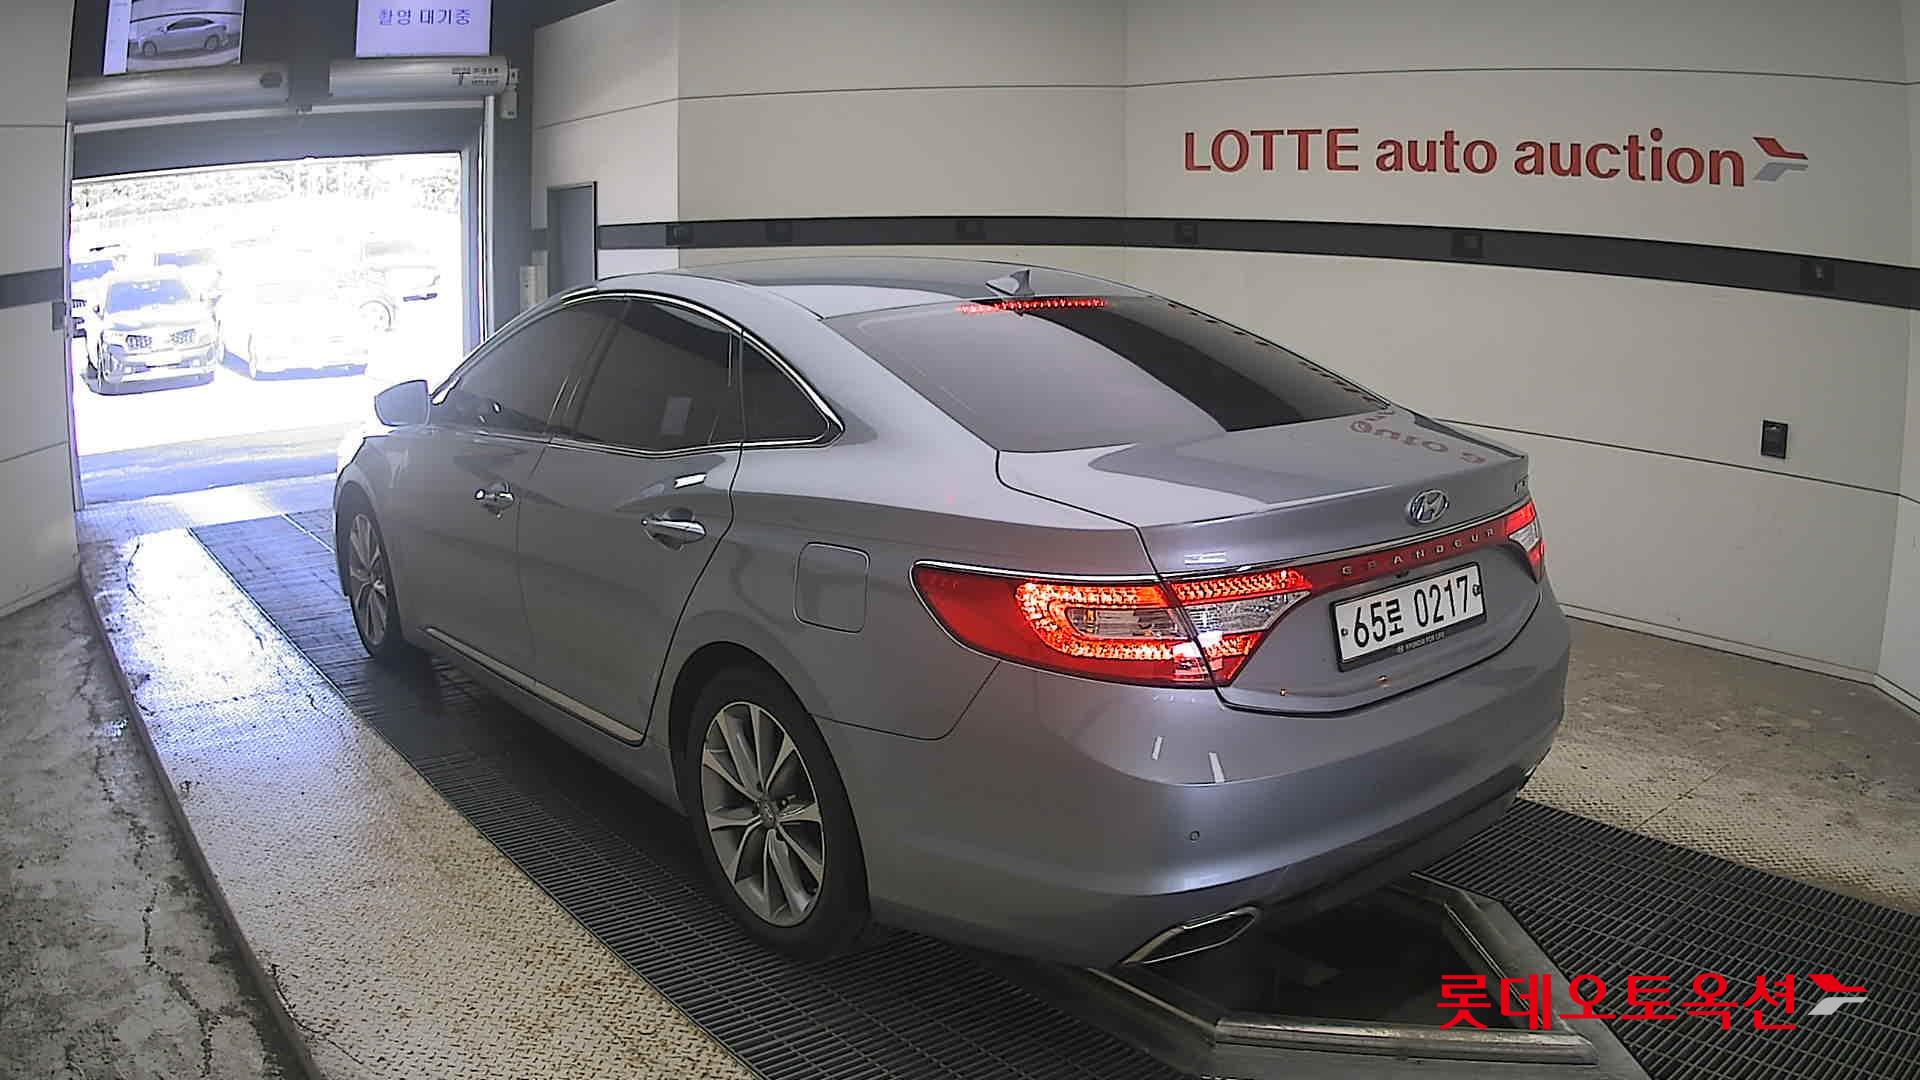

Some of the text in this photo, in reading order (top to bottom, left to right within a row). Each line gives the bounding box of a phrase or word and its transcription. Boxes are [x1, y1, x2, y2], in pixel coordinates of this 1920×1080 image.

[420, 8, 471, 25] 대기중
[1184, 127, 1745, 187] LOTTE auto auction
[1341, 527, 1495, 576] GRANDEUR
[1353, 575, 1469, 648] 65로 0217
